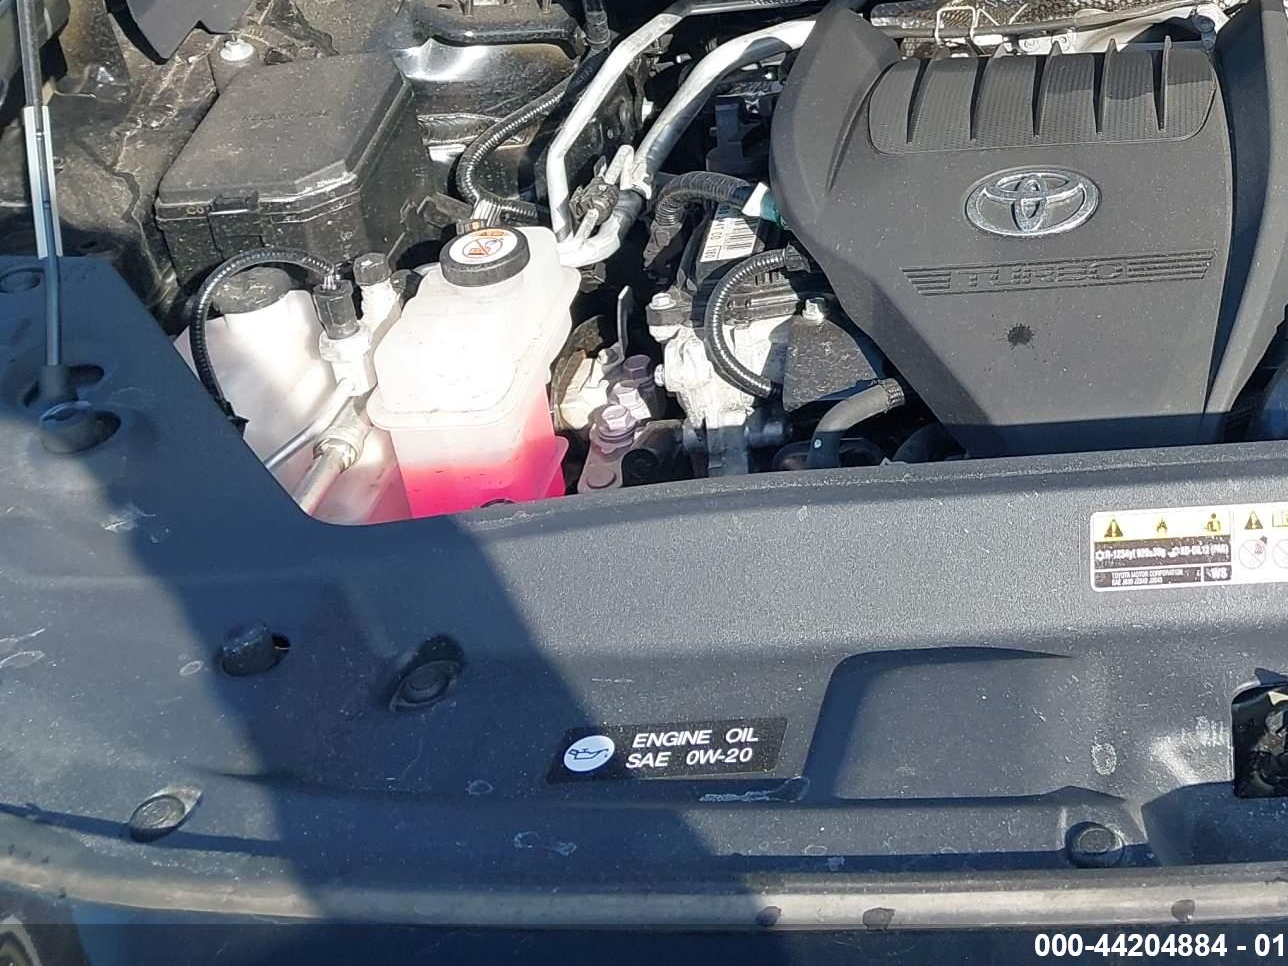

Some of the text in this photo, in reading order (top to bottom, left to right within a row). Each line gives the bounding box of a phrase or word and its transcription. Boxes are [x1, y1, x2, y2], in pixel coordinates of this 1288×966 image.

[955, 261, 1123, 287] TURBO
[1111, 571, 1131, 579] TOYOTA
[632, 727, 759, 748] ENGINE OIL
[625, 747, 752, 769] SAE 0W-20
